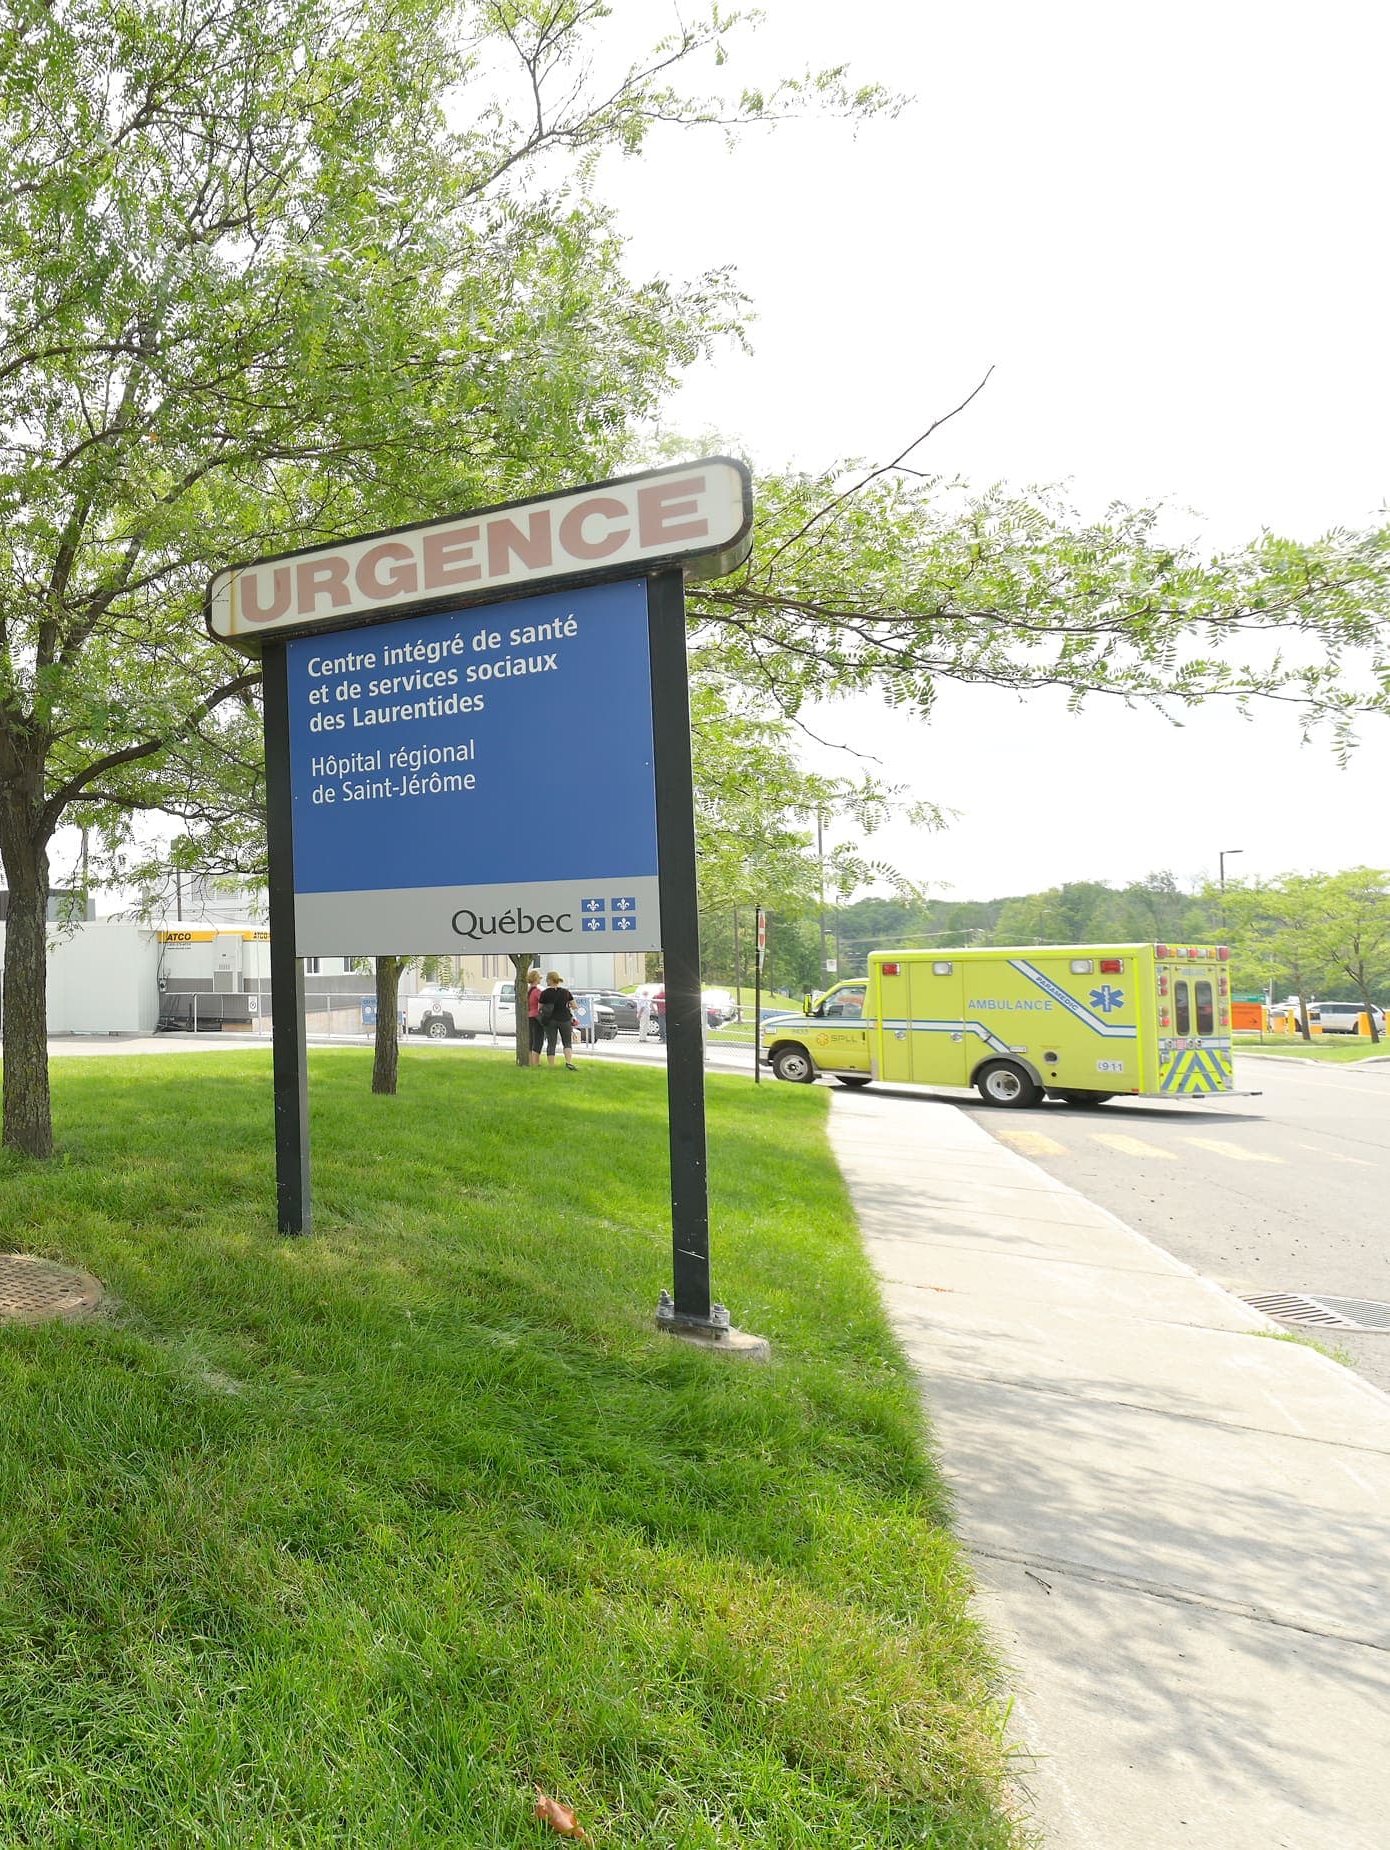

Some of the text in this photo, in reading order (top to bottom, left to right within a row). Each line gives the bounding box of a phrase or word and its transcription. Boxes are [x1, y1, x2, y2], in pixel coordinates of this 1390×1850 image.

[241, 476, 709, 623] URGENCE
[307, 614, 578, 678] Centre intégré de santé
[308, 653, 559, 705] et de services sociaux
[309, 693, 485, 733] des Laurentides
[311, 739, 476, 779] Hôpital régional
[312, 772, 477, 805] de Saint-Jérôme
[167, 933, 191, 941] ATCO
[451, 907, 574, 940] Québec
[968, 999, 1053, 1011] AMBULANCE
[1035, 976, 1079, 1011] PARAMEDIC
